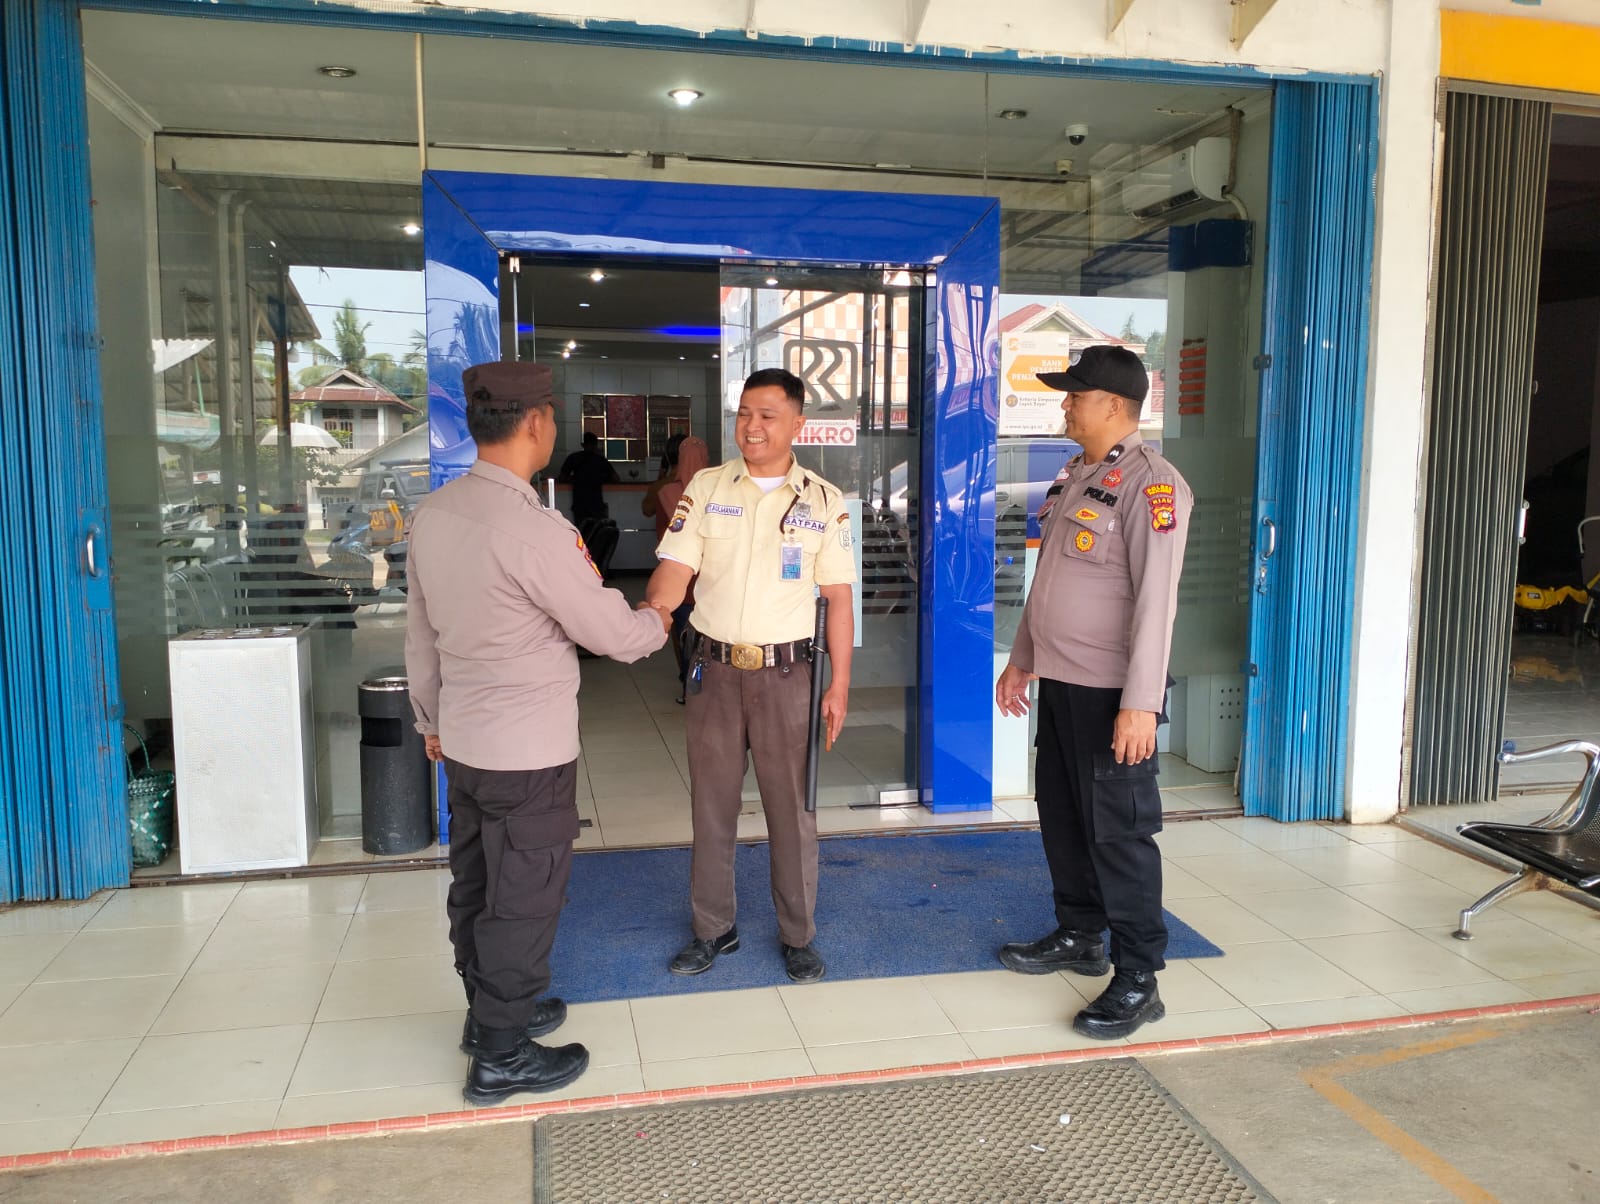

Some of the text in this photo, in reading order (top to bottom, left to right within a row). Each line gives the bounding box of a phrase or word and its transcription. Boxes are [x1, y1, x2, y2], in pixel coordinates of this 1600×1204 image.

[1083, 486, 1118, 507] POLRI
[1152, 497, 1172, 505] RIAU
[784, 517, 826, 532] SATPAM
